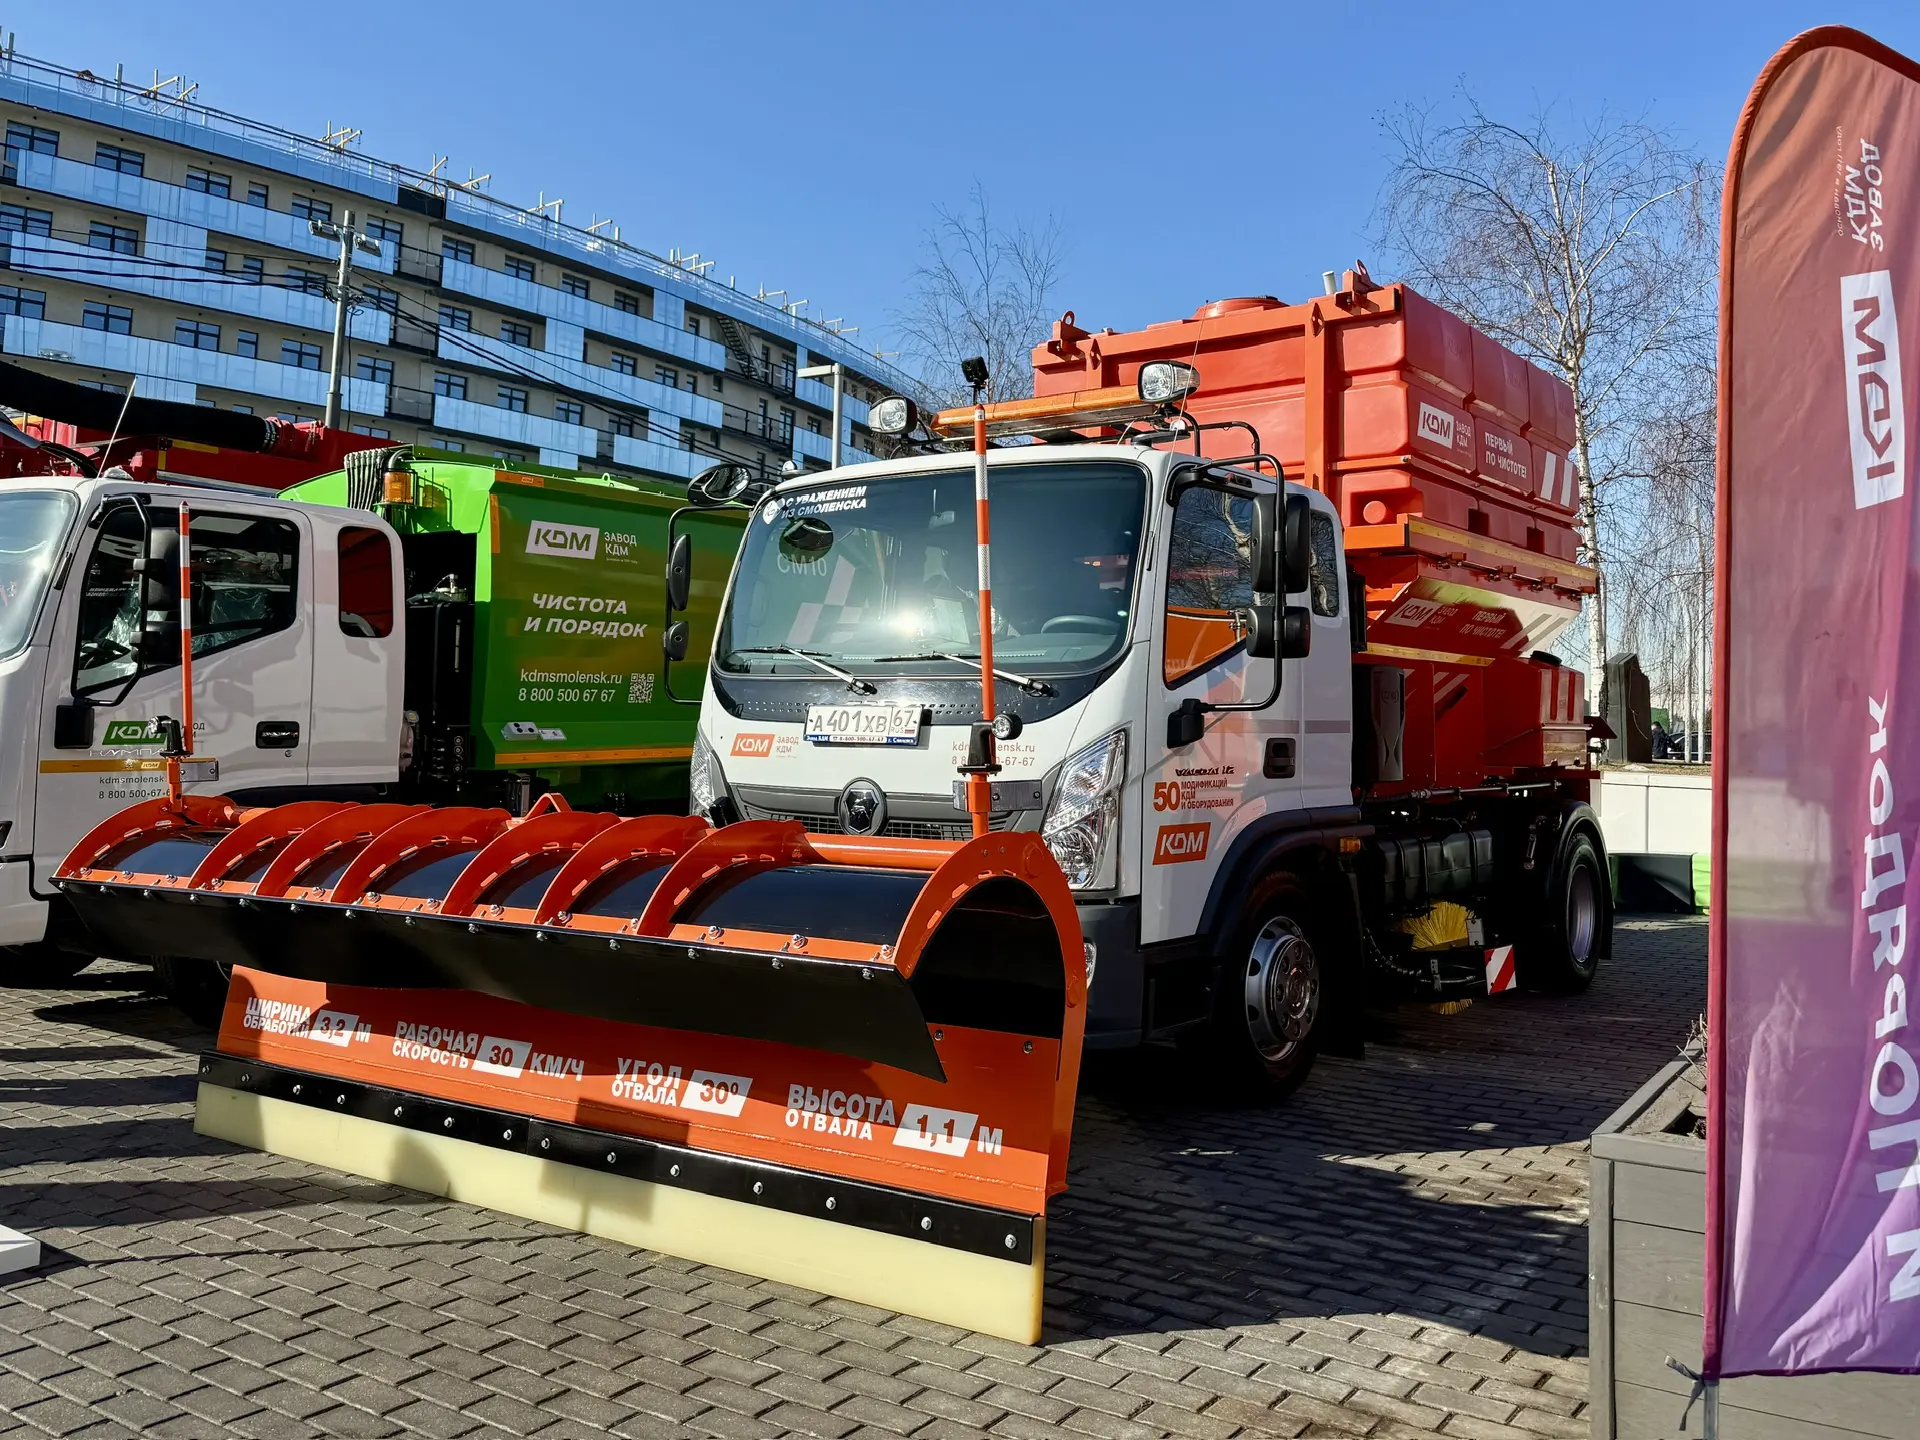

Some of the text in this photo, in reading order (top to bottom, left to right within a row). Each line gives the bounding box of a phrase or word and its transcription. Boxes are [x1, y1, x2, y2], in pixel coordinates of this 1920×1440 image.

[1422, 411, 1451, 439] KDM
[1456, 421, 1471, 437] ЗАВОД
[1456, 433, 1468, 447] КДМ
[1485, 432, 1513, 456] ПЕРВЫЙ
[1486, 451, 1496, 466] ПО
[1498, 456, 1527, 478] ЧИСТОТЕ!
[786, 486, 867, 506] С УВАЖЕНИЕМ
[781, 508, 795, 519] ИЗ
[797, 499, 866, 516] СМОЛЕНСКА
[535, 528, 591, 552] KDM
[604, 532, 637, 546] ЗАВОД
[605, 543, 628, 556] КДМ
[532, 593, 627, 614] ЧИСТОТА
[1472, 611, 1507, 623] ПЕРВЫЙ
[524, 617, 648, 639] И ПОРЯДОК
[1460, 624, 1474, 633] ПО
[520, 669, 622, 684] kdmsmolensk.ru
[518, 688, 616, 702] 8 800 500 67 67
[893, 709, 914, 728] 67
[111, 726, 161, 740] KDM
[777, 736, 799, 745] ЗАВОД
[735, 738, 769, 752] KDM
[776, 746, 792, 754] КДМ
[952, 742, 1035, 752] kdensk.ru
[100, 775, 168, 785] kdmsmolensk.
[1181, 779, 1228, 791] МОДИФИКАЦИЙ
[99, 790, 104, 799] 8
[108, 789, 125, 799] 800
[1153, 781, 1181, 812] 50
[1181, 790, 1196, 800] КДМ
[1181, 798, 1234, 810] И ОБОРУДОВАНИЯ
[1160, 831, 1205, 856] KDM
[246, 997, 311, 1025] ШИРИНА
[243, 1014, 310, 1039] ОБРАБОТКИ
[320, 1015, 372, 1043] 3,2 М
[395, 1021, 480, 1055] РАБОЧАЯ
[392, 1040, 469, 1069] СКОРОСТЬ
[489, 1045, 586, 1083] 30 КМ/Ч
[616, 1056, 682, 1088] УГОЛ
[610, 1077, 679, 1106] ОТВАЛА
[786, 1083, 896, 1126] ВЫСОТА
[784, 1107, 873, 1141] ОТВАЛА
[916, 1113, 1004, 1156] 1,1 М
